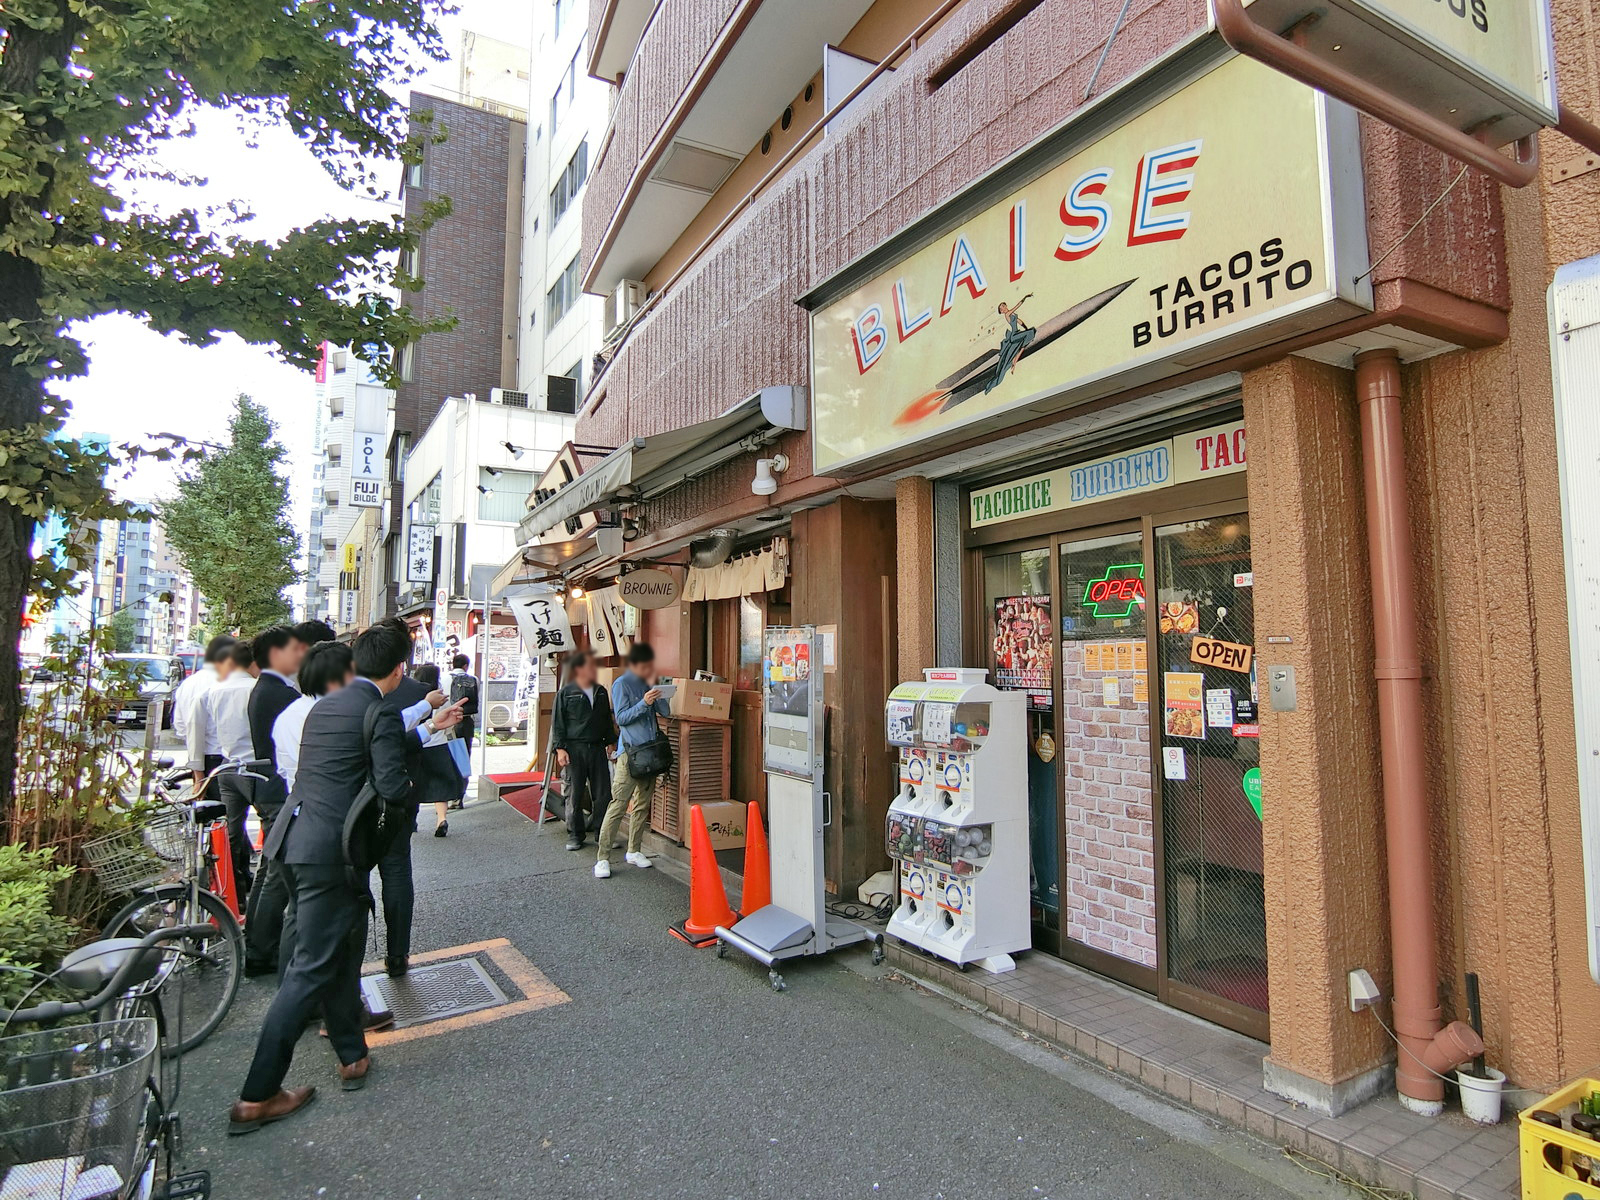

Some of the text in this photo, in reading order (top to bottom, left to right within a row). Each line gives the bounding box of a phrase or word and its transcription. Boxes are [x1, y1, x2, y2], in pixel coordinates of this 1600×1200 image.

[850, 138, 1204, 375] BLAISE
[1150, 237, 1285, 304] TACOS
[1133, 258, 1313, 348] BURRITO
[363, 436, 373, 474] POLA
[354, 481, 379, 495] FUJI
[972, 478, 1052, 521] TACORICE
[1070, 447, 1169, 502] BURRITO
[413, 557, 428, 575] 楽
[623, 582, 673, 595] BROWNIE
[523, 599, 565, 650] つけ麺
[1196, 642, 1247, 668] OPEN
